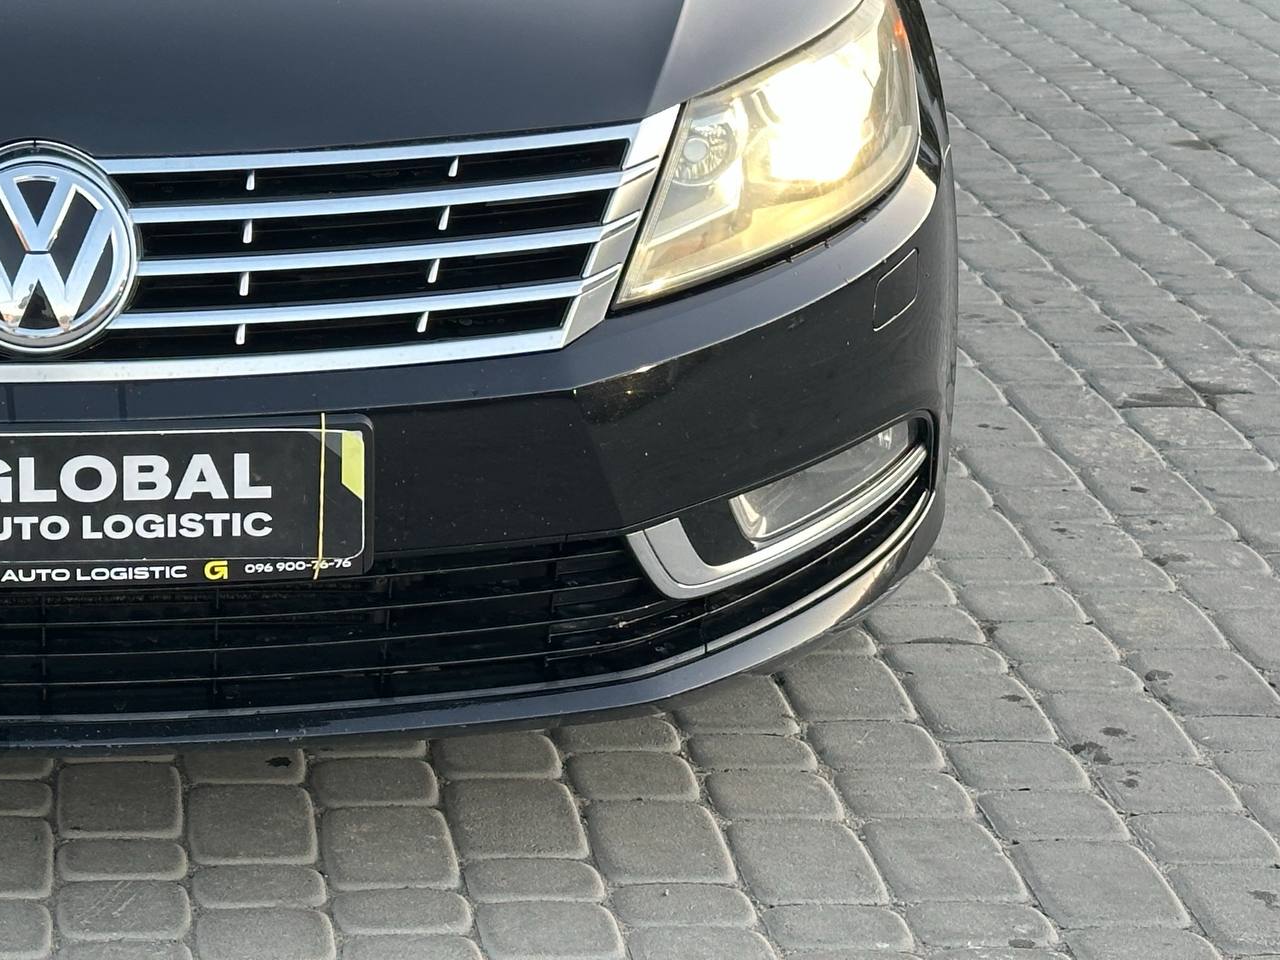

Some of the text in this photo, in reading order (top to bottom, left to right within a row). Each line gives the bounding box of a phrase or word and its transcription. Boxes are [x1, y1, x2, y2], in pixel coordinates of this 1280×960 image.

[83, 512, 272, 539] LOGISTIC
[0, 568, 71, 582] AUTO
[76, 565, 188, 581] LOGISTIC
[244, 558, 352, 574] 096 900-76-76
